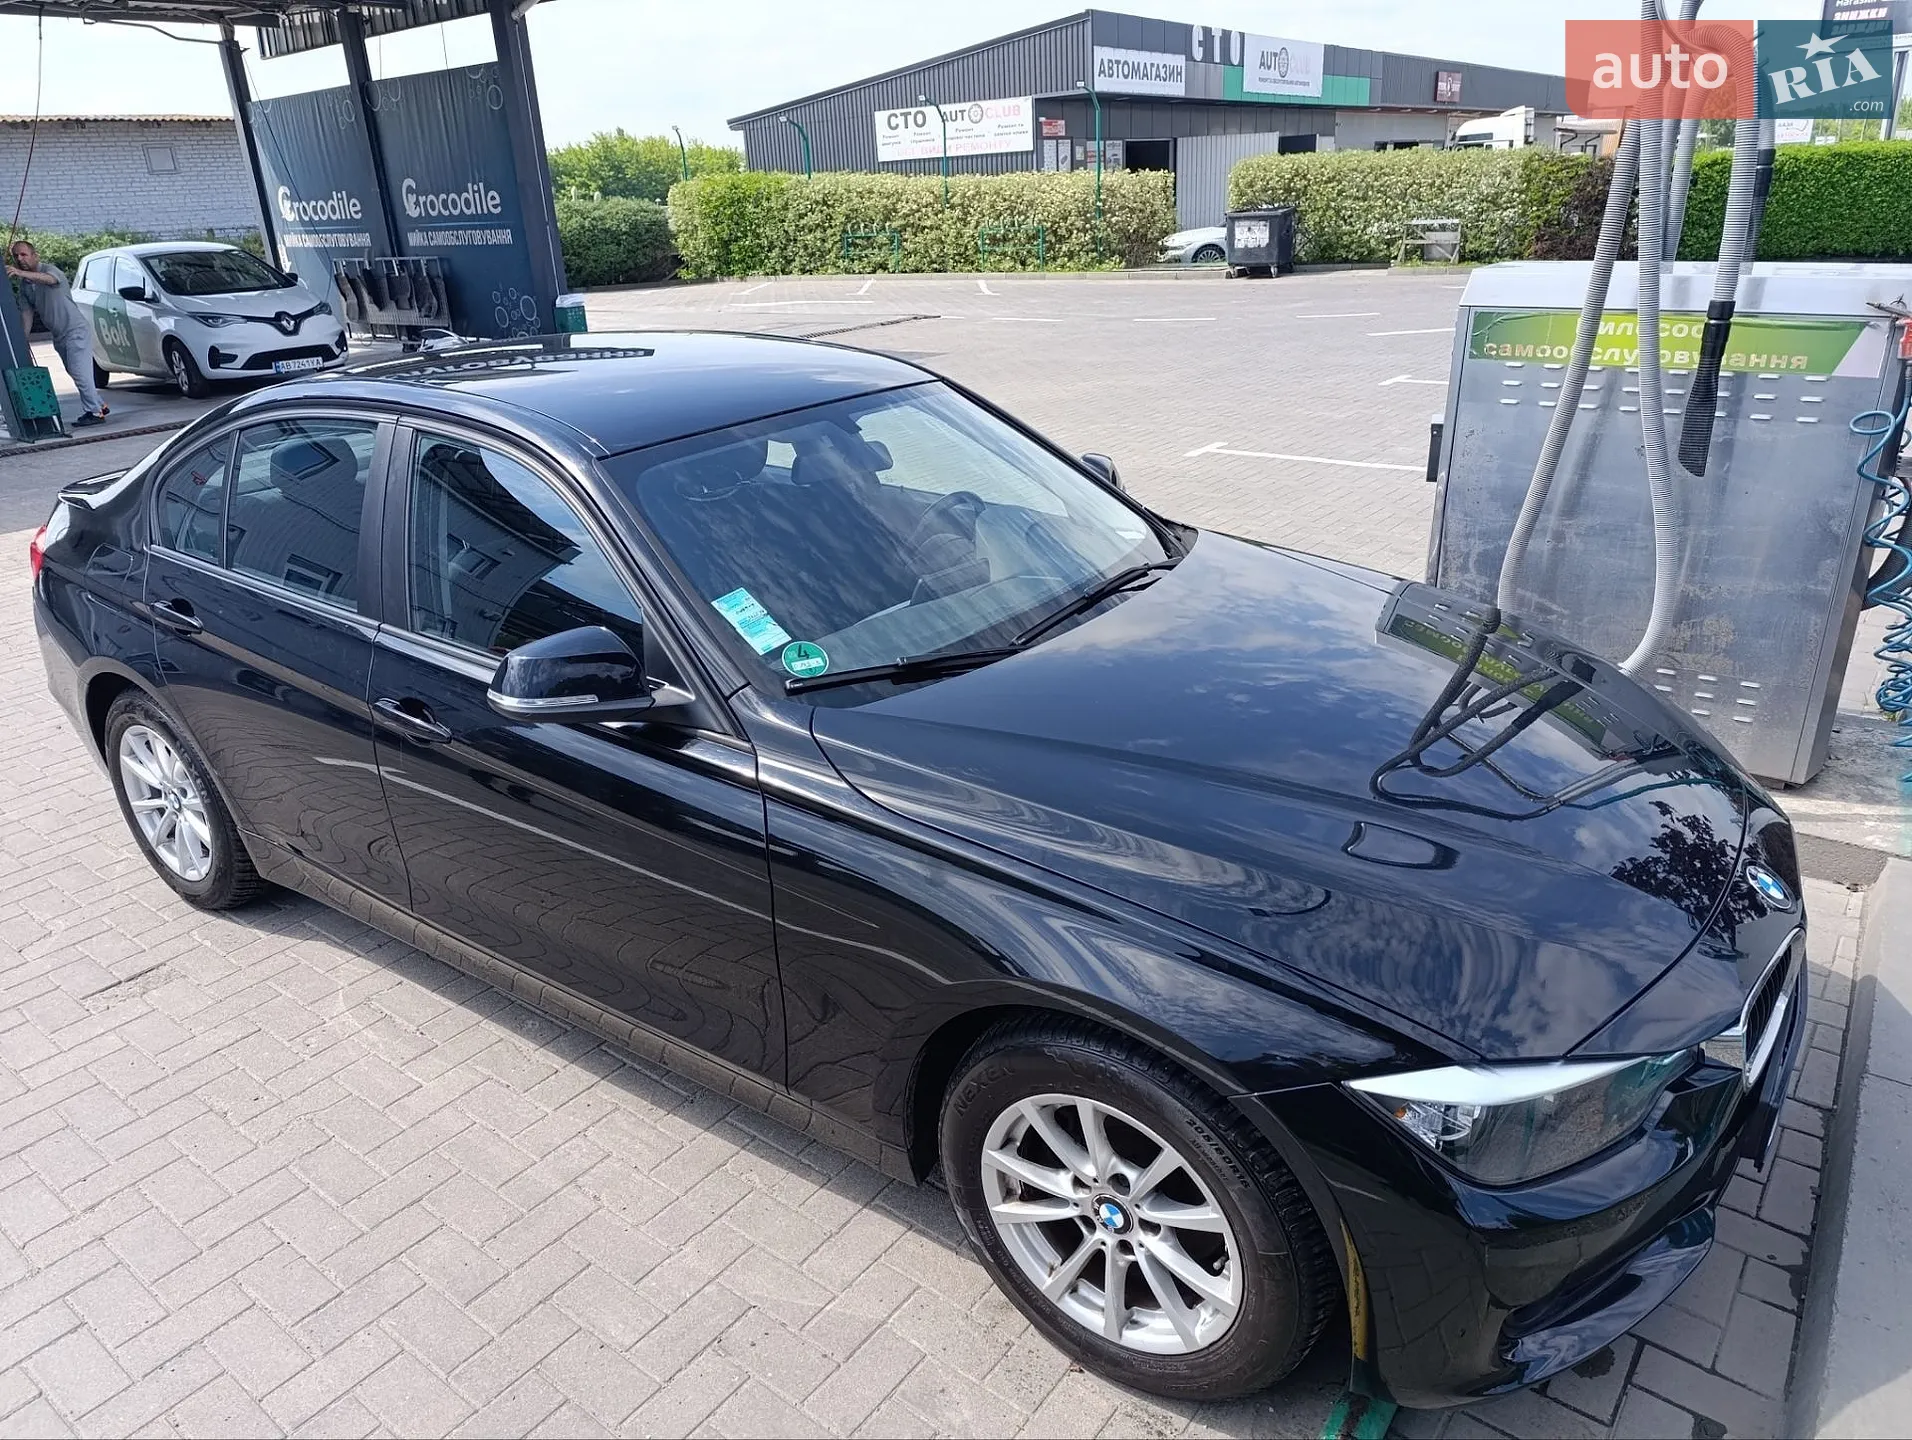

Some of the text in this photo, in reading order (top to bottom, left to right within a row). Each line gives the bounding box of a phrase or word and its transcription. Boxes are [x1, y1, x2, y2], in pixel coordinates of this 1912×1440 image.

[1833, 7, 1888, 21] ЗНИЖКИ
[1191, 25, 1241, 66] СТО
[1098, 58, 1183, 83] АВТОМАГАЗИН
[887, 110, 927, 131] СТО
[278, 186, 362, 222] Crocodile
[402, 178, 502, 218] Crocodile
[407, 229, 513, 247] МИЙКА САМООБСЛУГОВУВАННЯ
[98, 317, 130, 347] Bolt
[797, 644, 810, 659] 4
